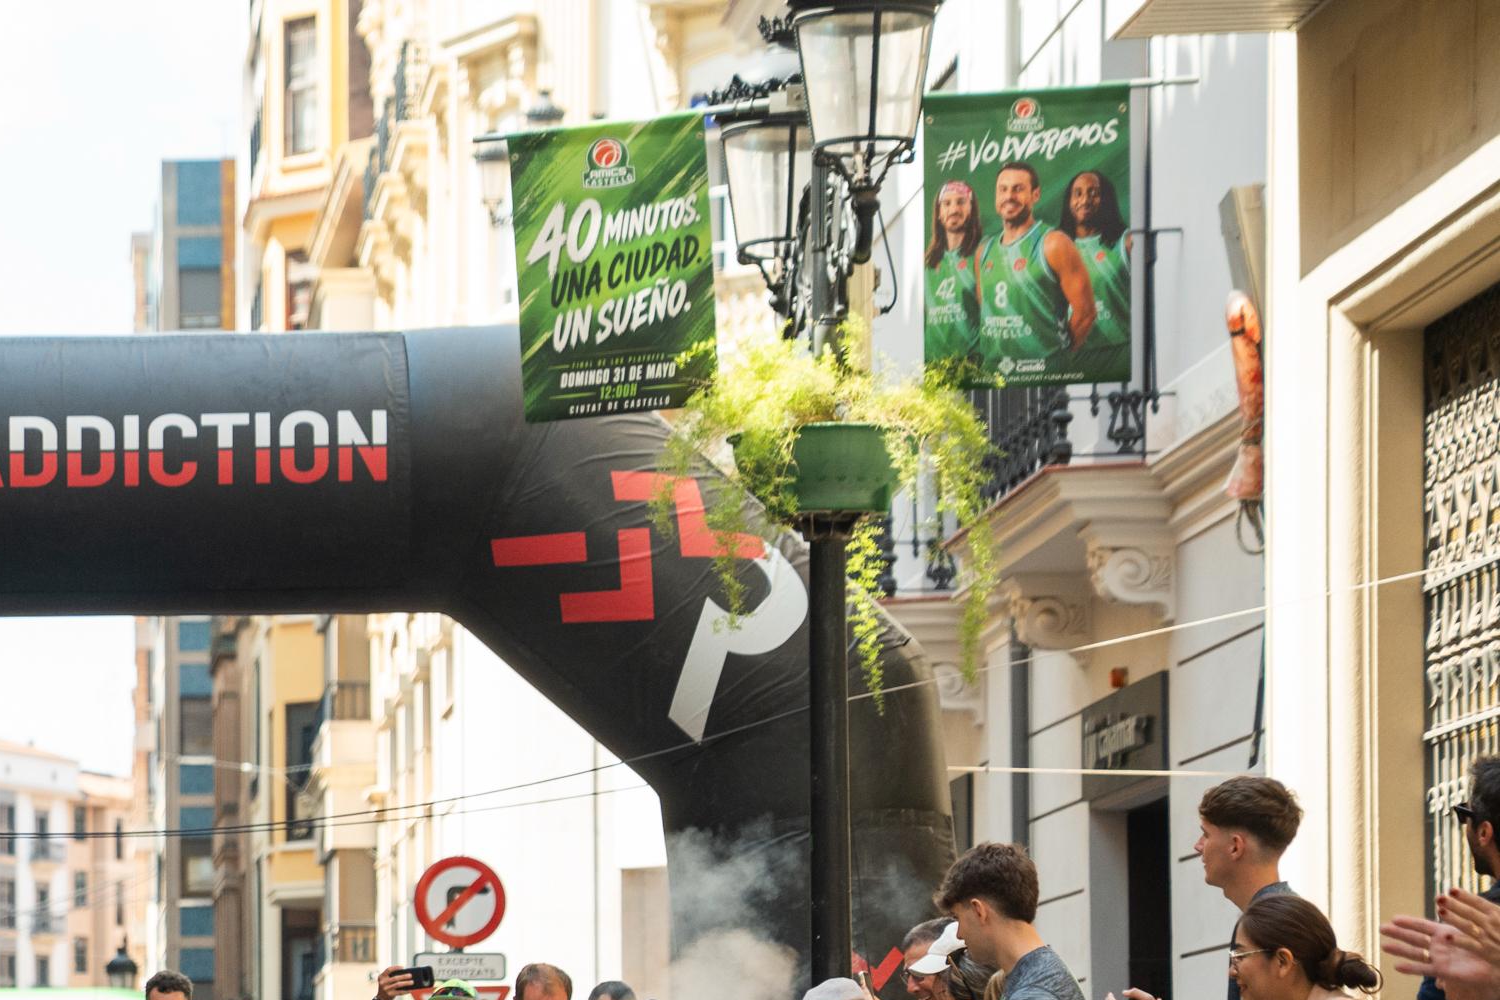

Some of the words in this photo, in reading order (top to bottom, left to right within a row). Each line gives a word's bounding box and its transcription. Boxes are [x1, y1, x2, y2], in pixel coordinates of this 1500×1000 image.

[936, 118, 1119, 173] #VOLVEREMOS
[526, 197, 602, 283] 40
[603, 193, 701, 249] MINUTOS.
[551, 262, 603, 308] UNA
[607, 234, 703, 290] CIUDAD.
[935, 276, 956, 300] 42
[995, 280, 1008, 309] 8
[553, 303, 593, 353] UN
[595, 277, 692, 346] SUEÑO.
[560, 368, 610, 389] DOMINGO
[613, 366, 626, 383] 31
[629, 365, 643, 381] DE
[646, 361, 677, 379] MAYO
[600, 383, 638, 400] 12:00H
[569, 402, 603, 415] CIUTAT
[607, 401, 618, 411] DE
